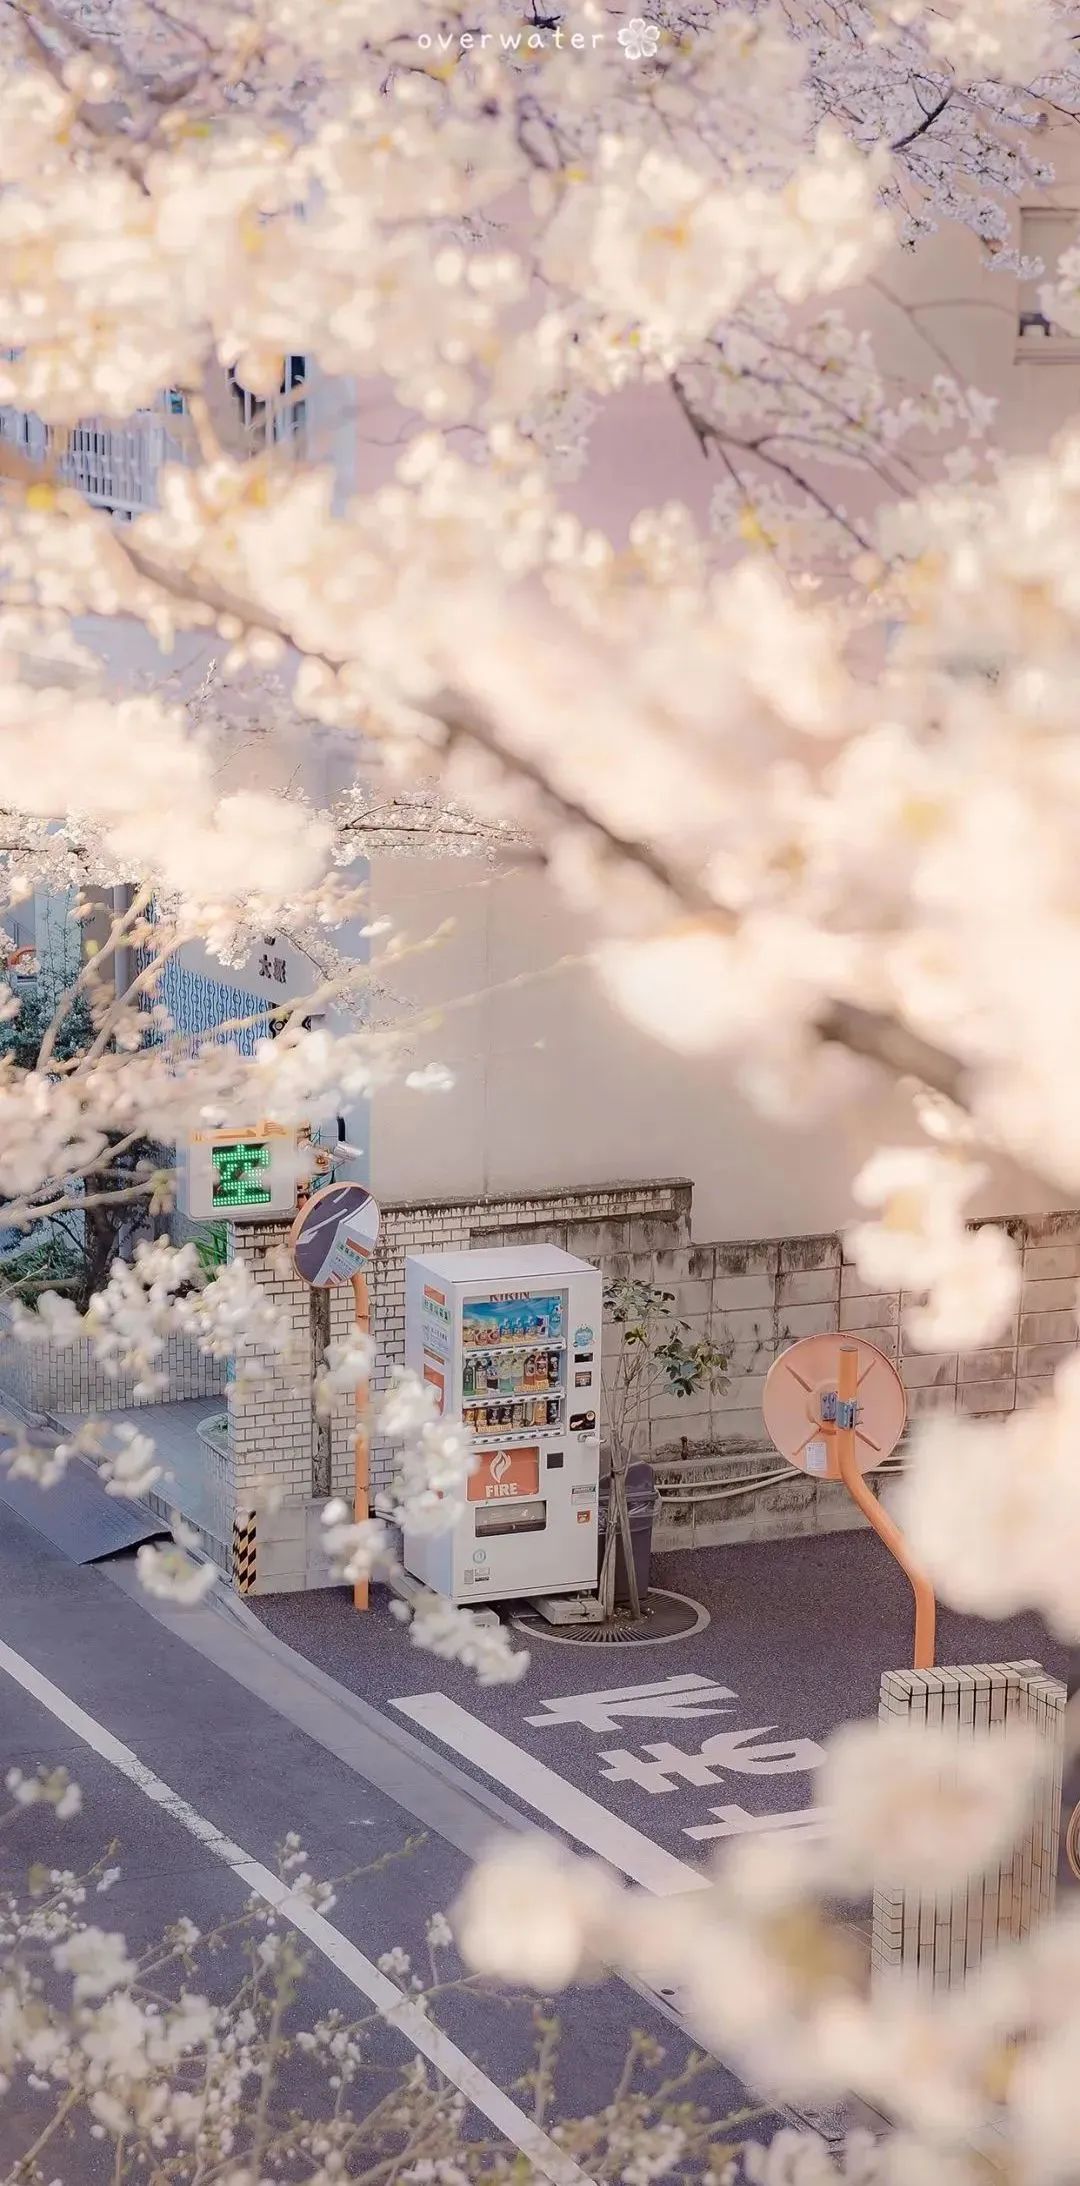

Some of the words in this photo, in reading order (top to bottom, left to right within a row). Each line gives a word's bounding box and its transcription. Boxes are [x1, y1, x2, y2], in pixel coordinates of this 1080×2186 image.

[212, 1143, 270, 1207] 空
[489, 1290, 531, 1303] KIRIN
[485, 1482, 519, 1498] FIRE
